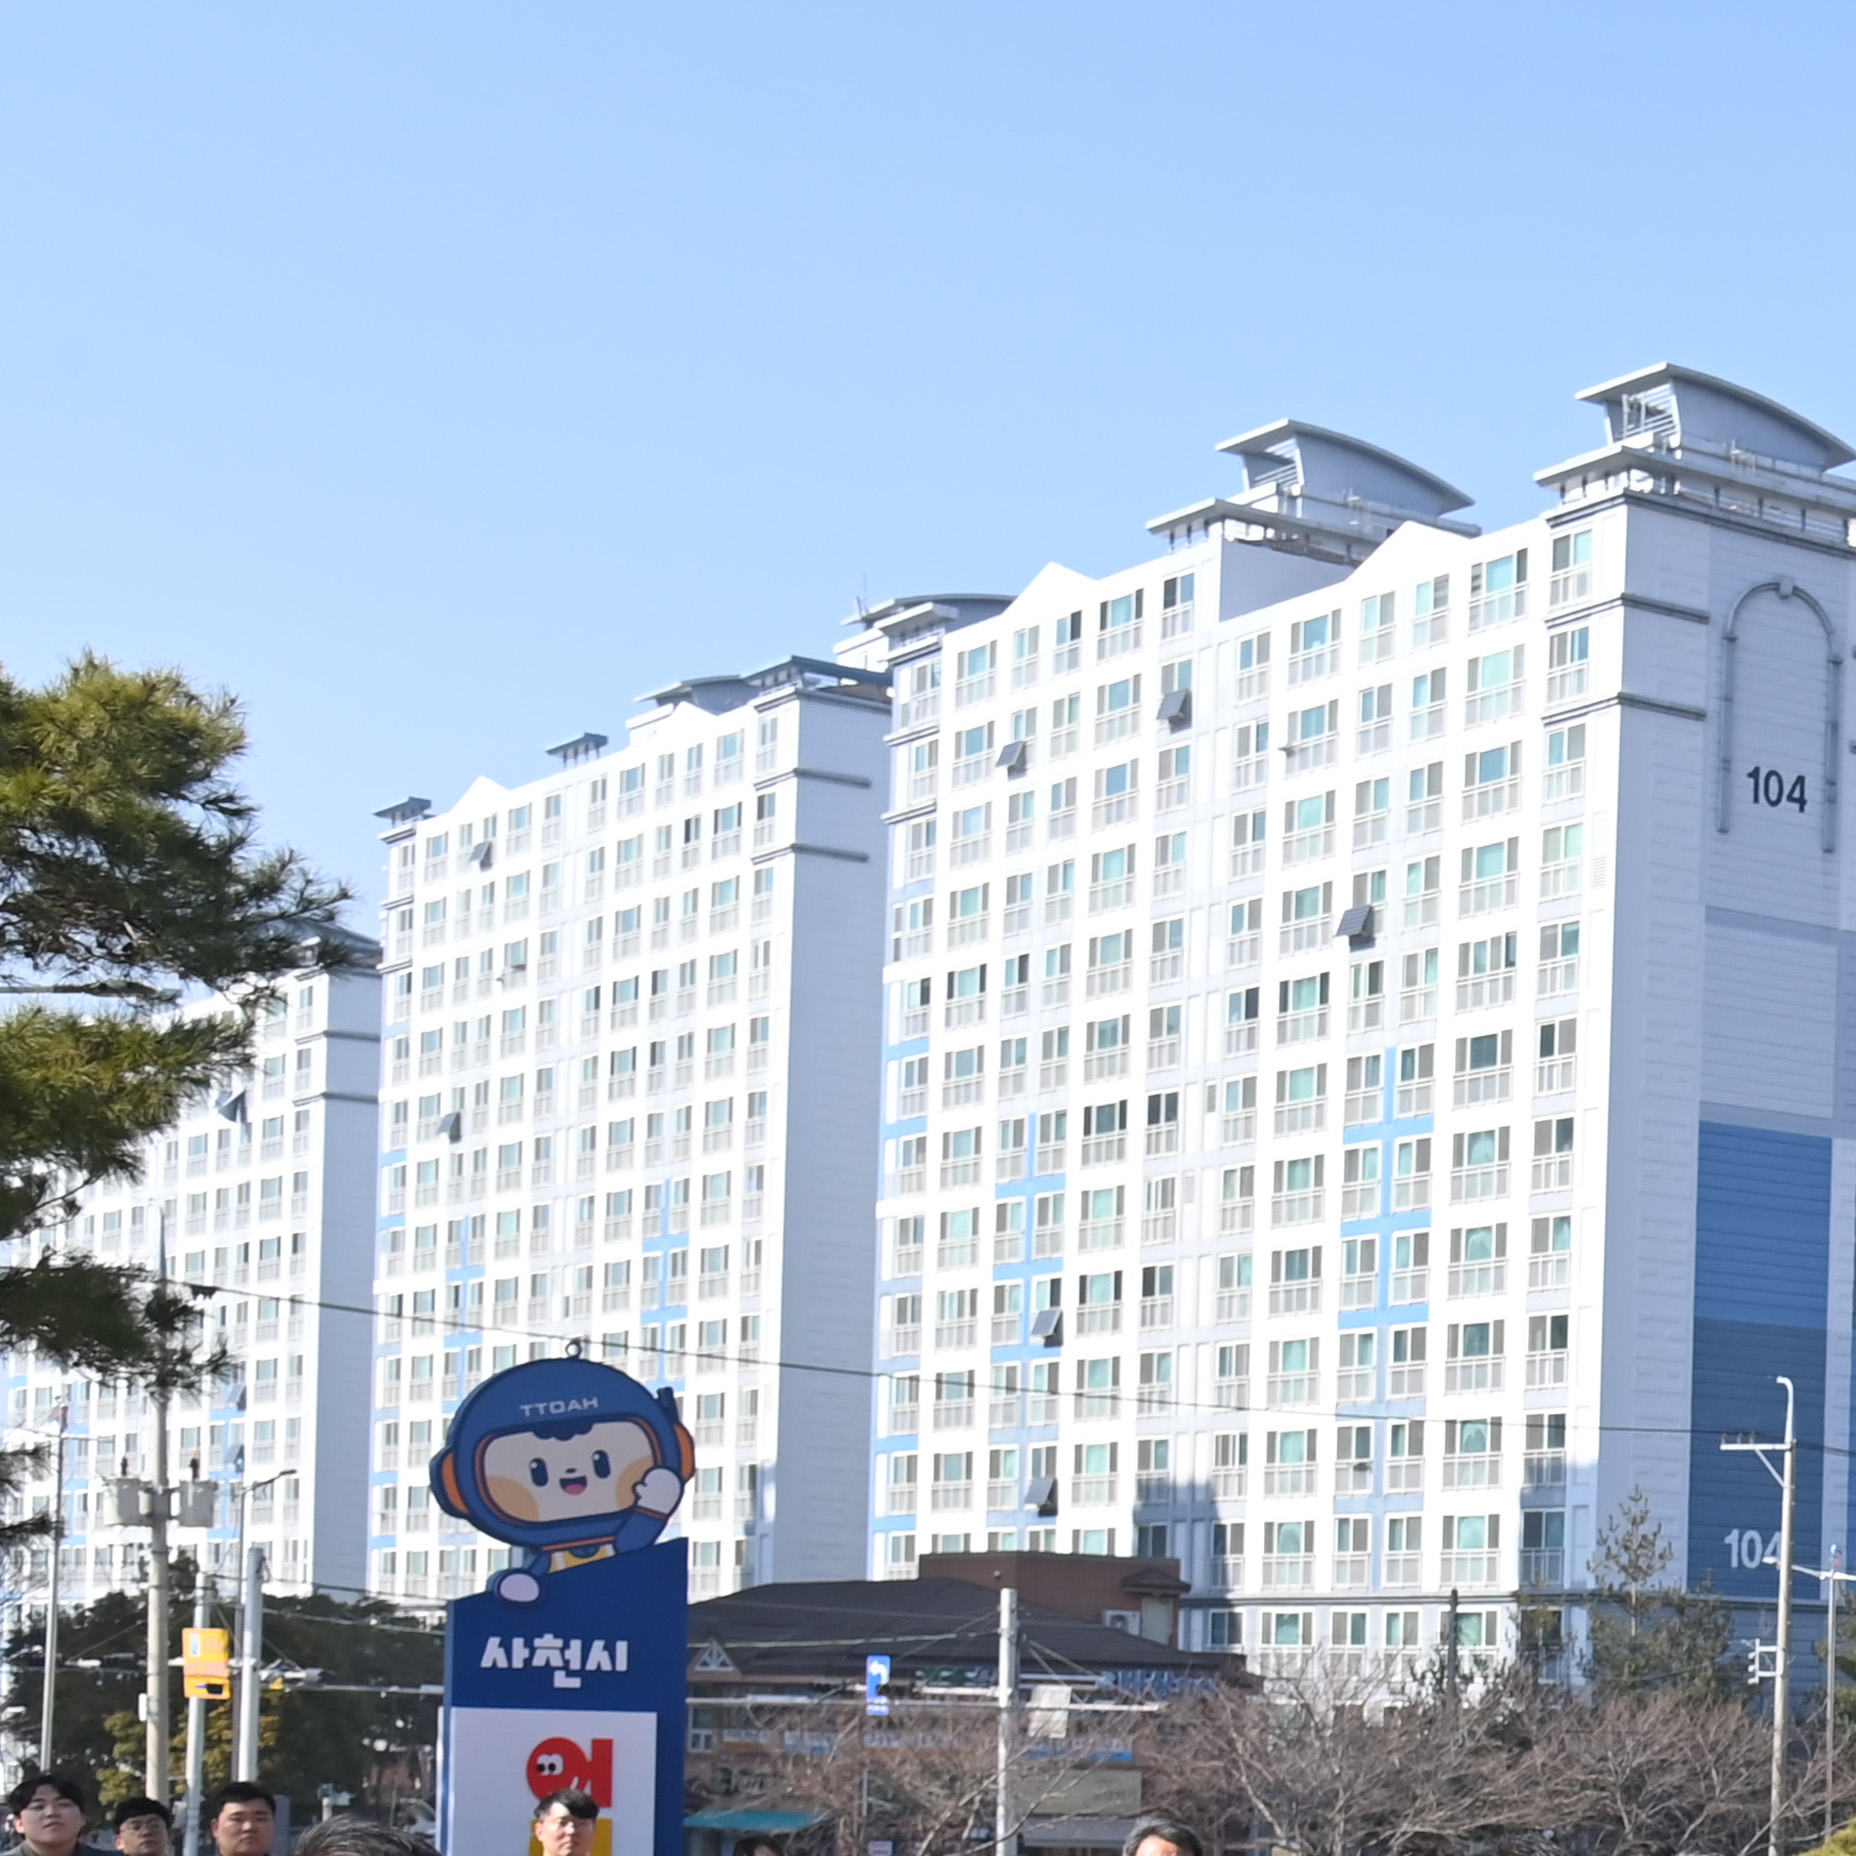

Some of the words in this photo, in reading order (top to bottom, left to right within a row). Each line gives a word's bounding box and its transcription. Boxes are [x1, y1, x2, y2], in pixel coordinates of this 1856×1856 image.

[1746, 766, 1808, 814] 104
[519, 1396, 599, 1417] TTOAH
[480, 1632, 629, 1689] 사천시
